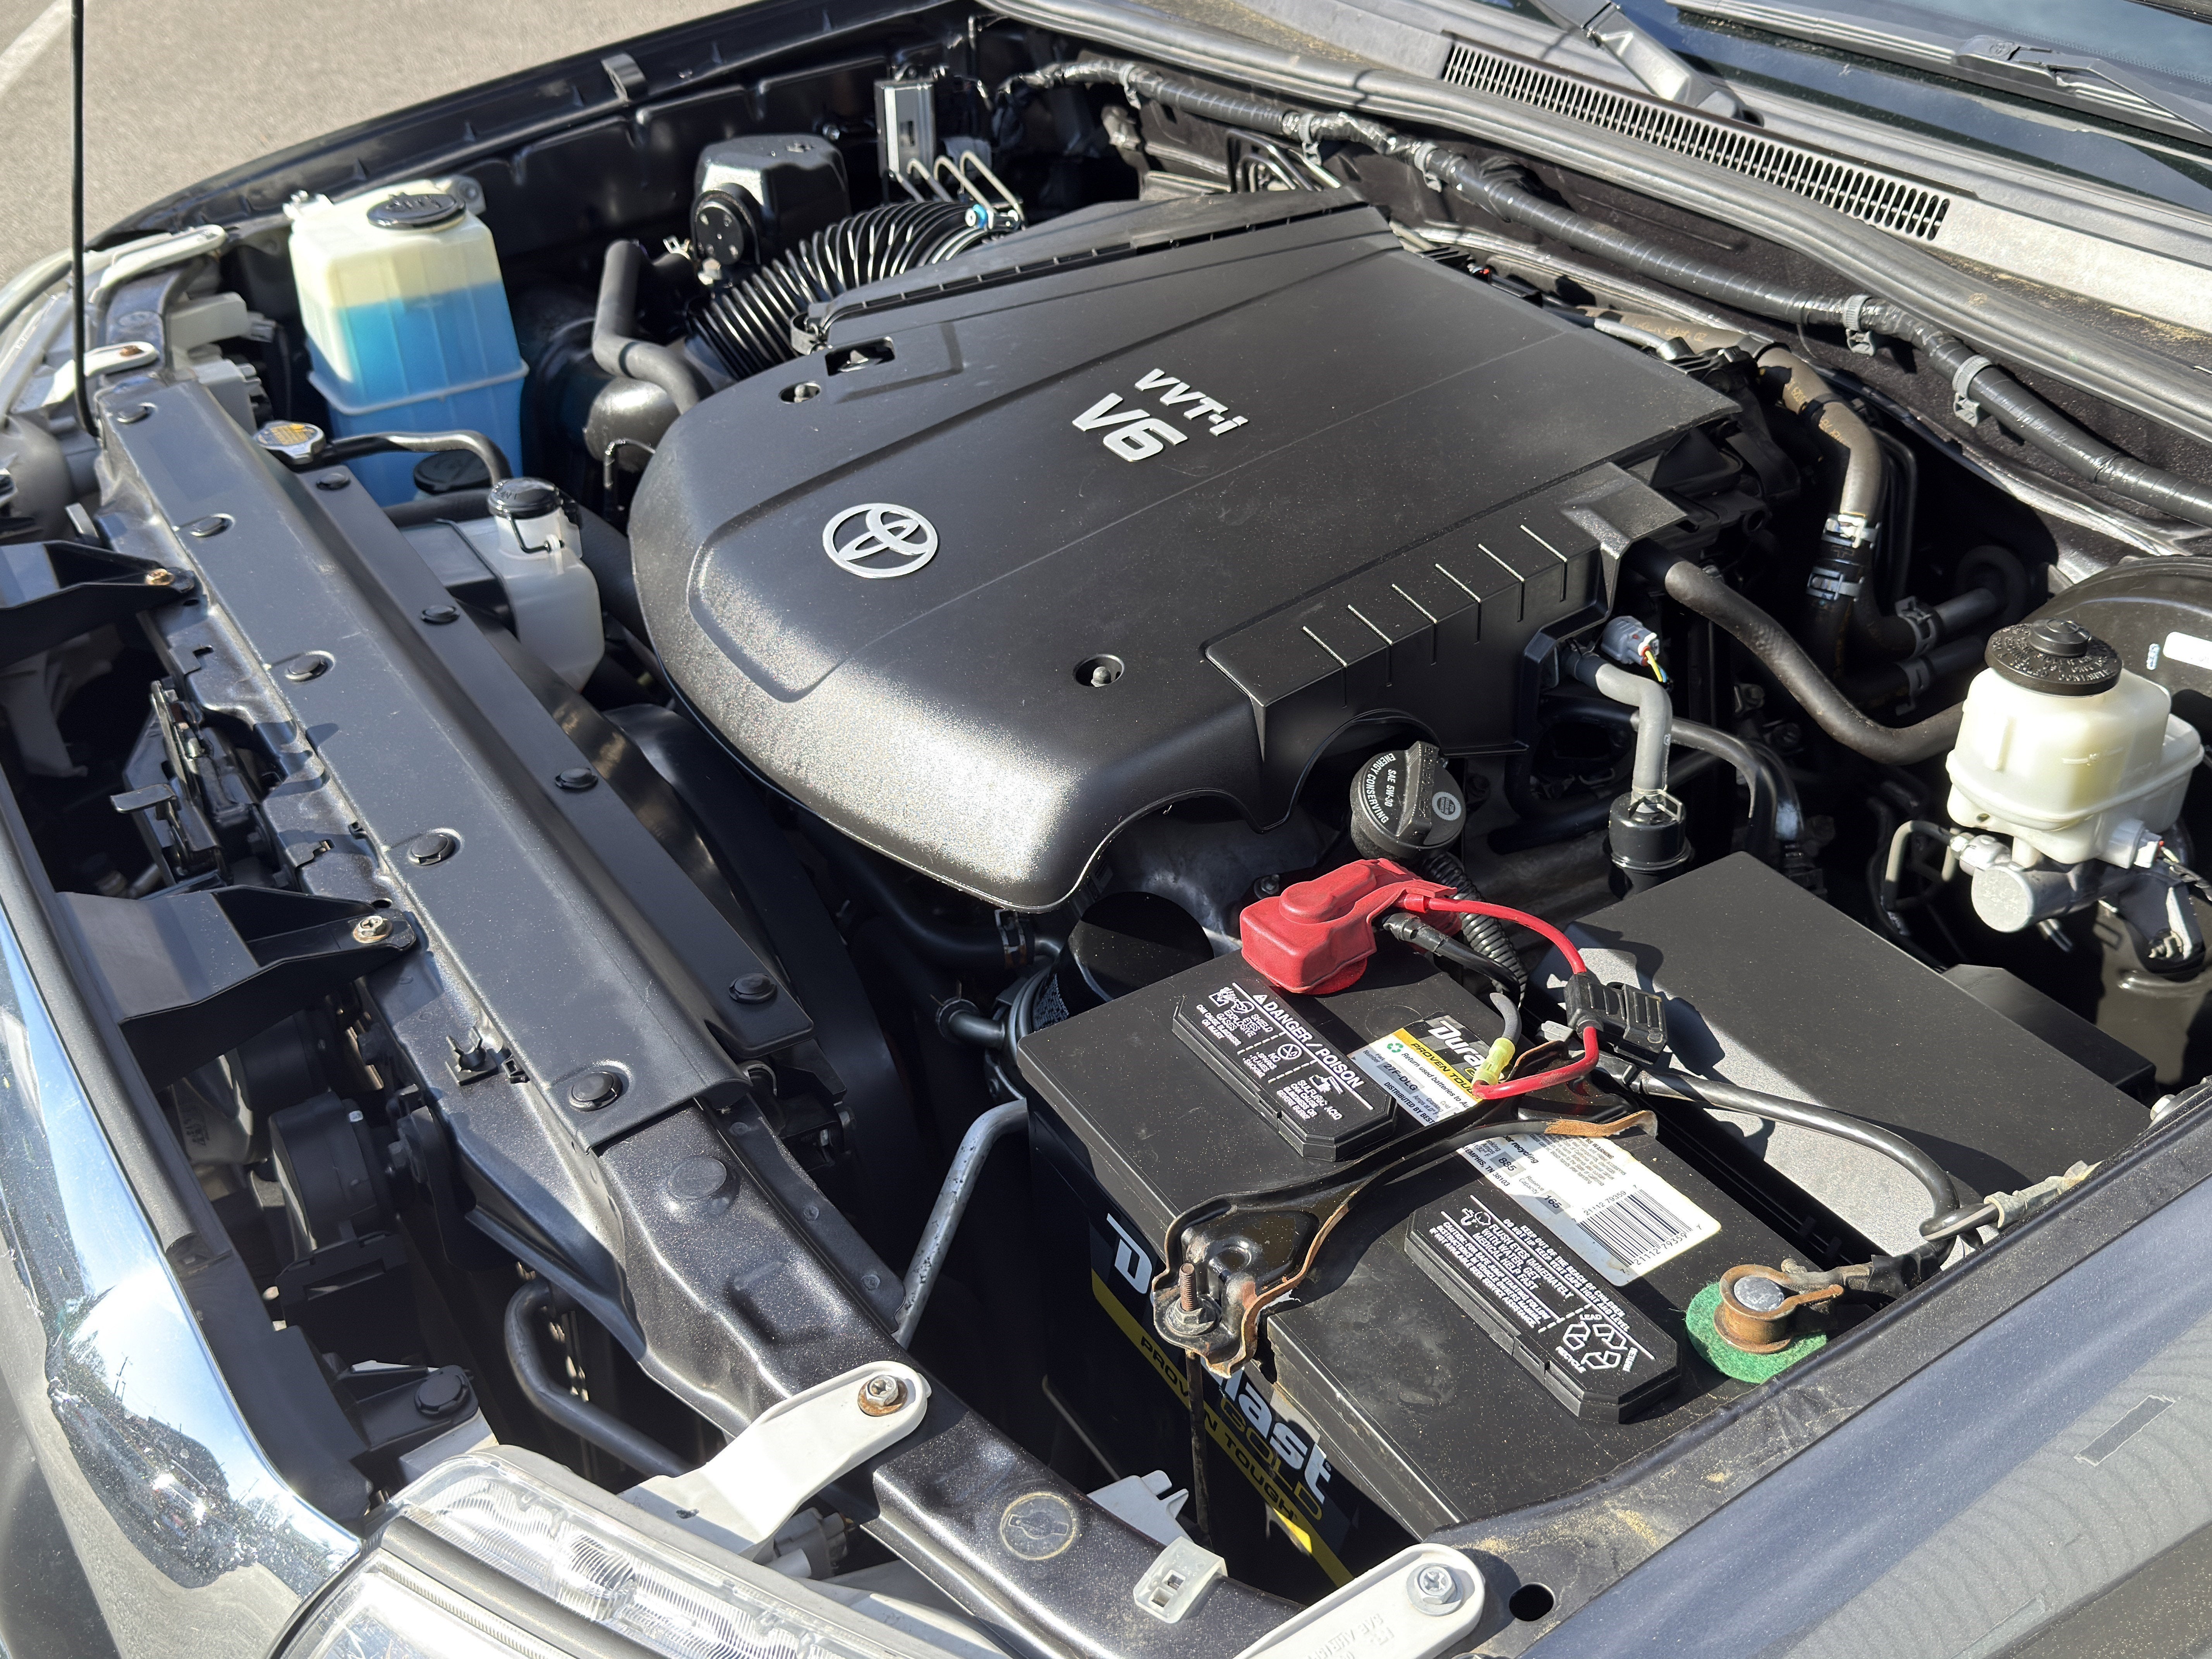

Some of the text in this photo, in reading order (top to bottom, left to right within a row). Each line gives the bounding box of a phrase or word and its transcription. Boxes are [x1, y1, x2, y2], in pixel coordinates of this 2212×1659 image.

[1135, 368, 1248, 436] VVT-i
[1072, 393, 1188, 462] V6
[1366, 753, 1396, 824] ENERGY CONSERVING
[1384, 769, 1396, 807] SAE 5W-30
[1196, 1004, 1208, 1014] CAN
[1217, 1013, 1237, 1031] GASES
[1224, 1010, 1257, 1038] EXPLOSIVE
[1243, 1017, 1261, 1031] EYES
[1251, 1014, 1273, 1032] SHIELD
[1263, 1001, 1312, 1042] DANGER
[1315, 1048, 1364, 1088] POISON
[1268, 1053, 1281, 1062] NO
[1363, 1050, 1380, 1063] Number
[1383, 1063, 1418, 1091] 27F-DLG
[1401, 1053, 1420, 1068] Return
[1419, 1066, 1435, 1079] used
[1431, 1076, 1455, 1096] batteries
[1410, 1043, 1479, 1099] PROVEN TOUG
[1283, 1086, 1317, 1117] BLINDNESS OR
[1291, 1084, 1318, 1108] CAN CAUSE
[1298, 1080, 1342, 1120] SULFURIC ACID
[1384, 1082, 1436, 1124] DISTRIBUTED BY BEST
[1412, 1095, 1426, 1106] Amps
[1482, 1144, 1495, 1154] Amps
[1498, 1158, 1517, 1171] 885
[1511, 1141, 1539, 1163] recycling
[1592, 1143, 1614, 1159] WARNING
[1492, 1172, 1510, 1186] 38103
[1525, 1175, 1544, 1191] Reserve
[1544, 1195, 1562, 1208] 165
[1605, 1190, 1626, 1204] 79359
[1436, 1225, 1473, 1259] INSTRUCTIONS
[1476, 1262, 1500, 1283] VEHICLE
[1473, 1233, 1540, 1290] MEDICAL HELP FAST
[1482, 1228, 1541, 1280] WITH WATER. GET
[1489, 1224, 1574, 1298] FLUSH EYES IMMEDIATELY
[1520, 1225, 1537, 1238] KEEP
[1535, 1238, 1549, 1249] OUT
[1547, 1248, 1558, 1256] OF
[1555, 1256, 1569, 1267] THE
[1566, 1264, 1587, 1283] REACH
[1585, 1283, 1597, 1291] OF
[1633, 1248, 1661, 1265] 21112
[1661, 1232, 1688, 1249] 79359
[1465, 1243, 1478, 1254] FOR
[1475, 1252, 1491, 1265] SAFE
[1489, 1263, 1505, 1278] JUMP
[1502, 1277, 1530, 1300] STARTING
[1526, 1299, 1551, 1319] FOLLOW
[1470, 1266, 1486, 1279] SEEK
[1482, 1277, 1506, 1298] SERVICE
[1503, 1219, 1514, 1227] DO
[1511, 1226, 1525, 1238] NOT
[1535, 1247, 1552, 1261] KEEP
[1550, 1260, 1567, 1274] VENT
[1564, 1274, 1582, 1288] CAPS
[1580, 1287, 1601, 1303] TIGHT
[1597, 1303, 1613, 1315] AND
[1610, 1313, 1630, 1331] LEVEL
[1141, 1335, 1297, 1520] PROVN TOUGH
[1220, 1397, 1322, 1520] GOLD
